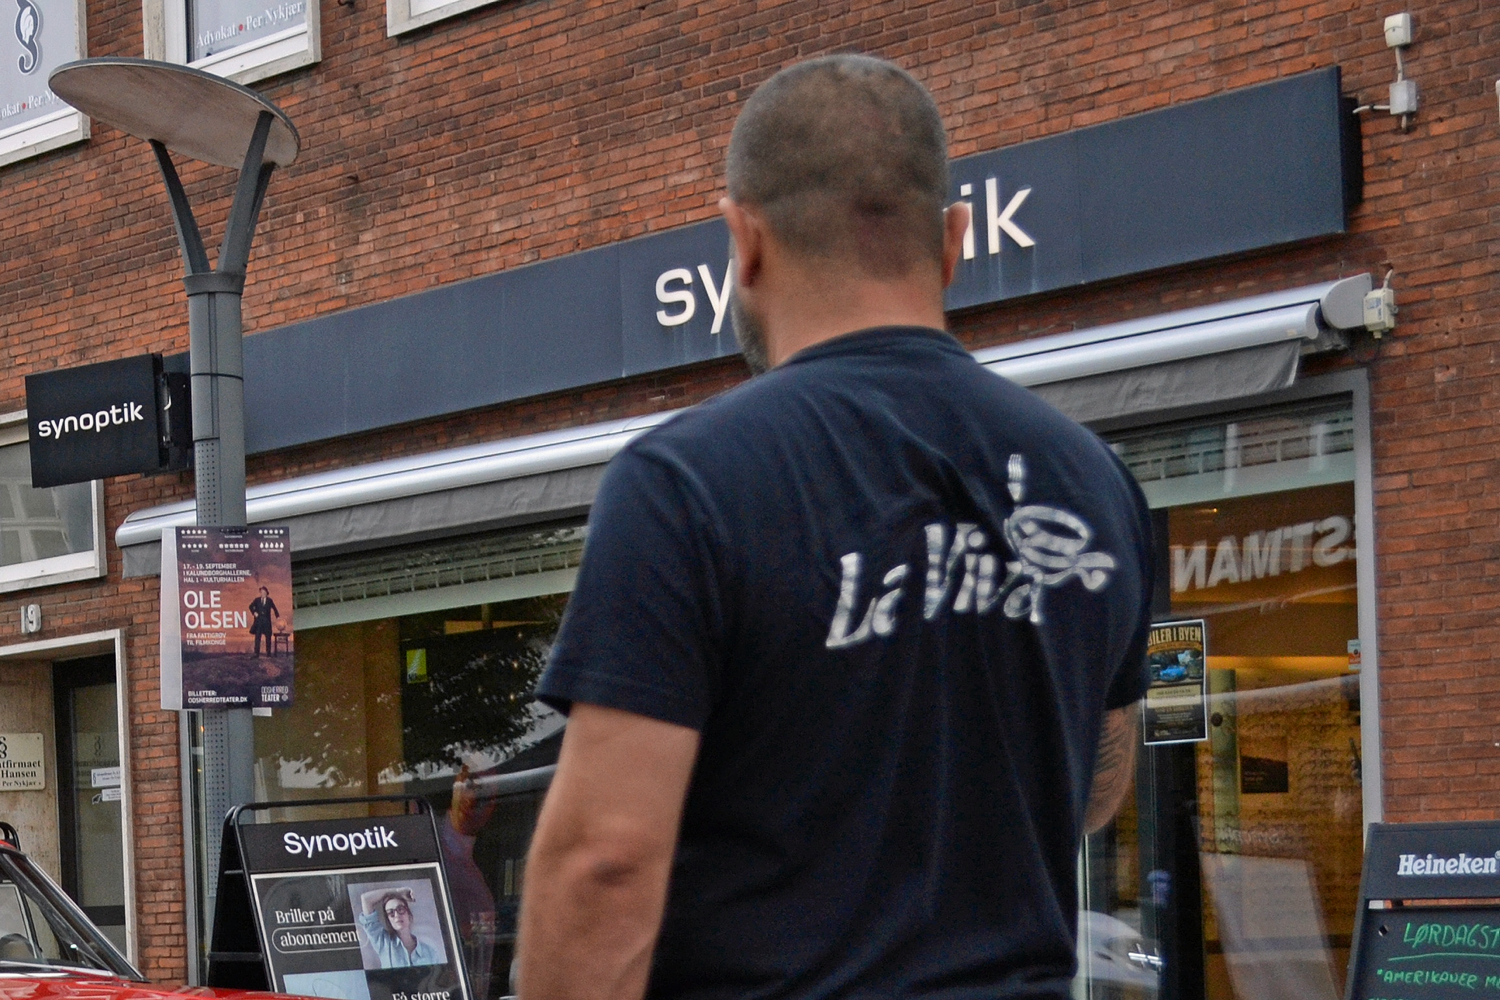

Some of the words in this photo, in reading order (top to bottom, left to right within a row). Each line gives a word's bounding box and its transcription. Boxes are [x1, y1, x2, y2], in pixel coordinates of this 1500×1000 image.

[196, 24, 236, 48] Advokat
[245, 15, 262, 30] Per
[265, 2, 302, 25] Nykjær
[28, 95, 42, 109] Per
[37, 401, 144, 439] synoptik
[183, 590, 221, 609] OLE
[21, 604, 41, 633] 19
[184, 611, 247, 629] OLSEN
[1178, 626, 1201, 642] BYEN
[1, 770, 37, 779] Hansen
[283, 825, 398, 858] Synoptik
[275, 906, 315, 924] Briller
[318, 906, 335, 924] på
